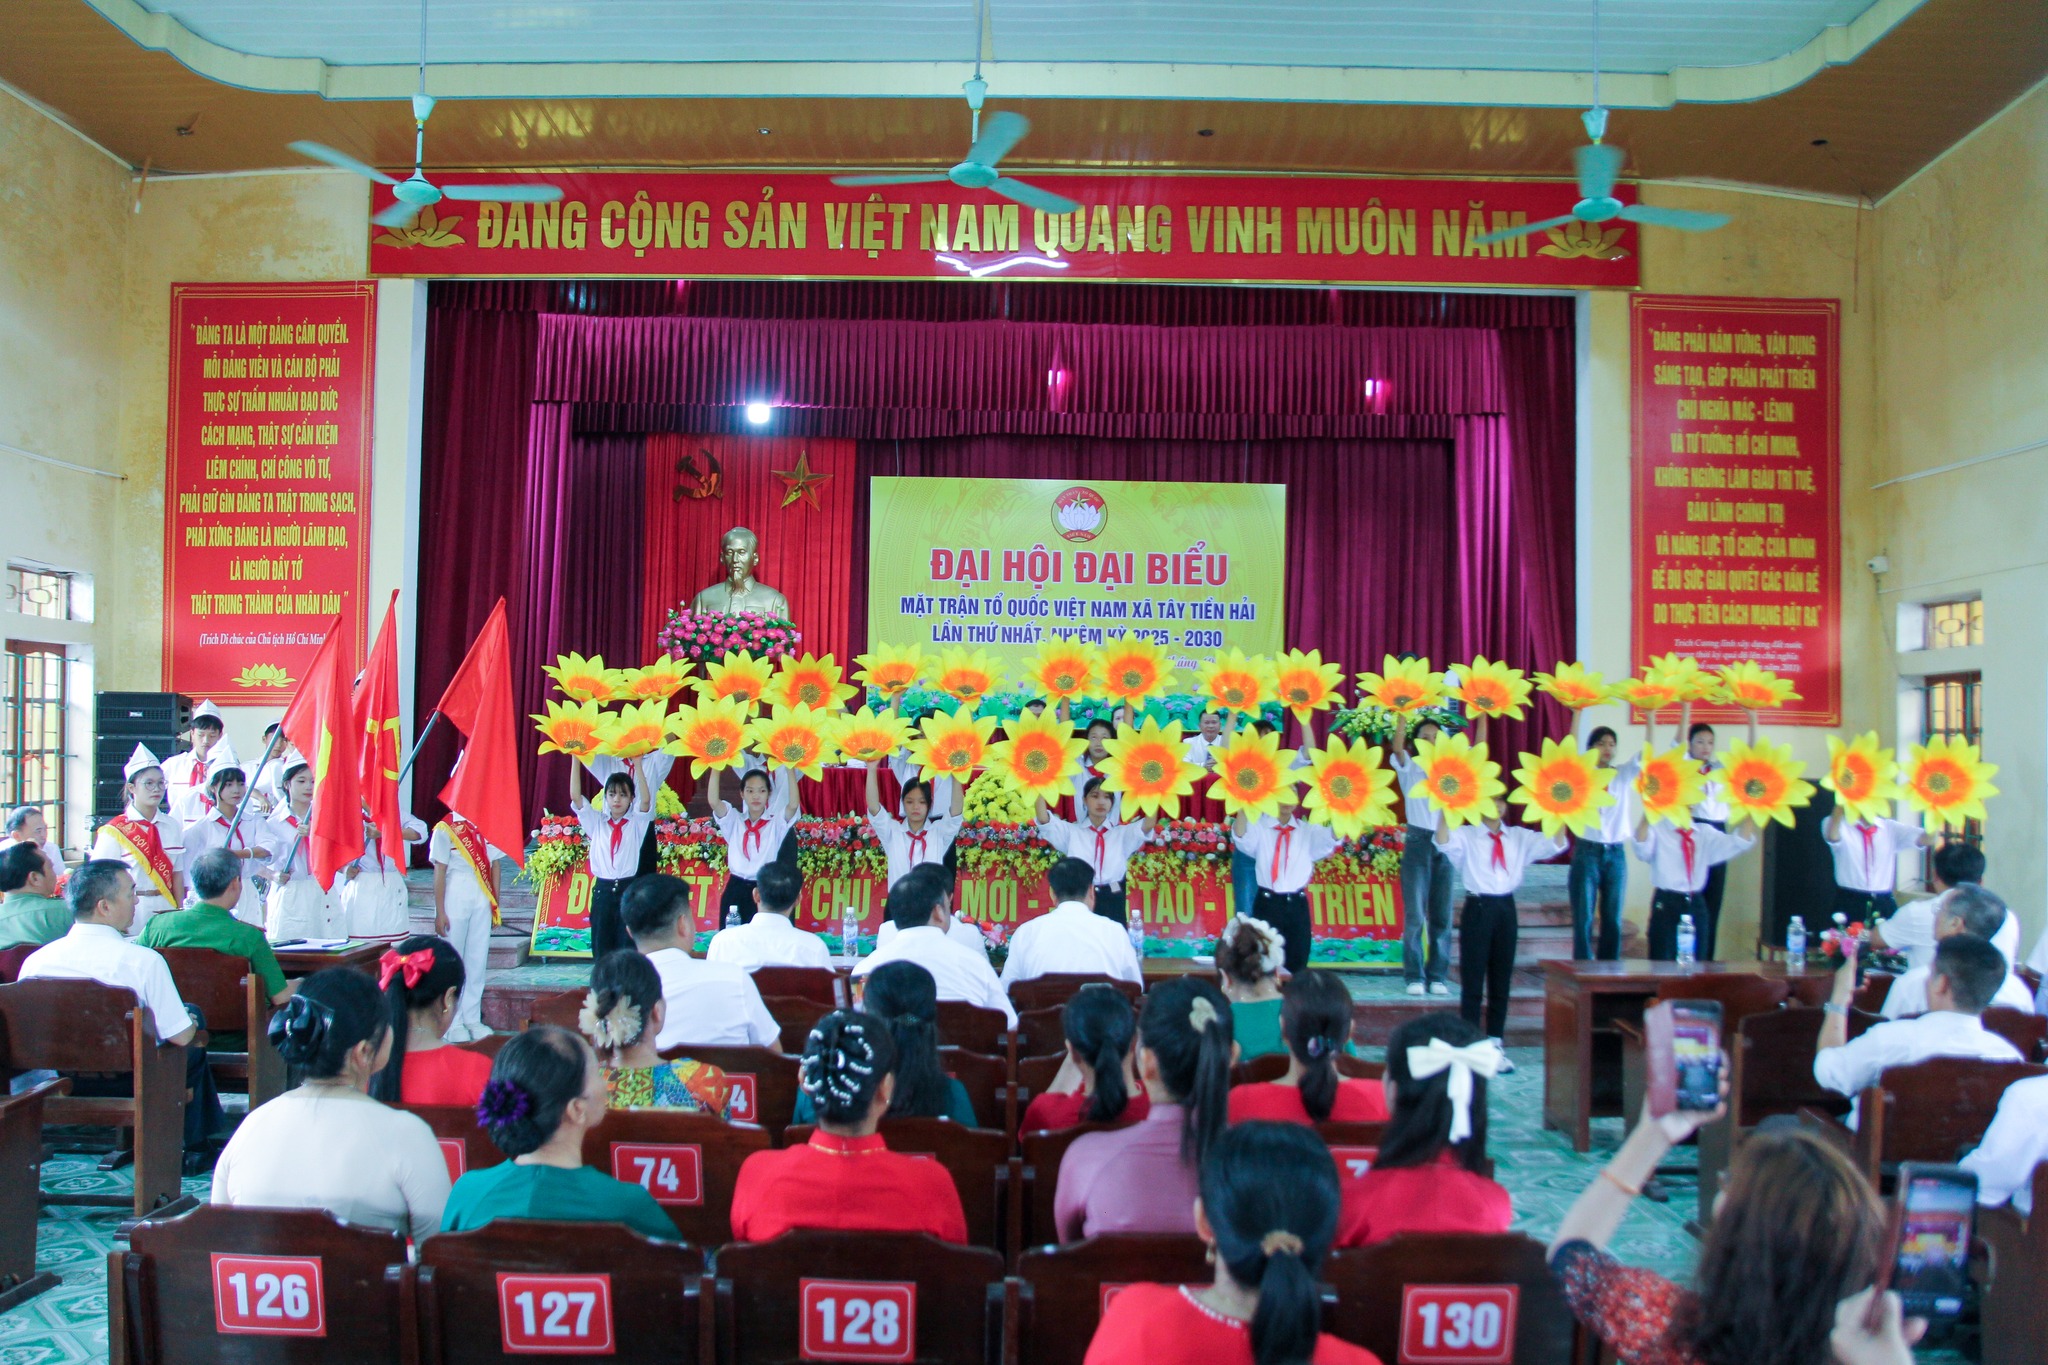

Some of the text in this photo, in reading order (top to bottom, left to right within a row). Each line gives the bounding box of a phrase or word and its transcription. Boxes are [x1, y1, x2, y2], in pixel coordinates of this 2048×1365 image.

[600, 190, 710, 258] CỘNG
[723, 185, 807, 249] SẢN
[824, 192, 910, 259] VIỆT
[920, 203, 1019, 252] NAM
[1033, 204, 1172, 257] QUANG
[1187, 205, 1282, 254] VINH
[1297, 197, 1417, 256] MUÔN
[1432, 199, 1528, 258] NĂM
[222, 325, 233, 344] TA
[235, 321, 246, 344] LÀ
[248, 321, 268, 349] MỘT
[269, 316, 294, 343] ĐẢNG
[295, 316, 316, 343] CẦM
[203, 349, 340, 382] MỖI ĐẢNG VIÊN VÀ CÁN BỘ PHẢI
[203, 391, 225, 416] THỰC
[227, 390, 241, 416] SỰ
[300, 391, 318, 415] ĐẠO
[320, 385, 338, 410] ĐỨC
[201, 416, 338, 449] CÁCH MẠNG, THẬT SỰ CẦN KIỆM
[206, 455, 227, 479] LIÊM
[229, 455, 259, 481] CHÍNH,
[261, 454, 277, 478] CHÍ
[278, 454, 302, 478] CÔNG
[304, 454, 316, 477] VÔ
[179, 485, 356, 516] PHẢI GIỮ GÌN ĐẢNG TA THẬT TRONG SẠCH,
[185, 519, 348, 550] PHẢI XỨNG ĐÁNG LÀ NGƯỜI LÃNH ĐẠO,
[230, 556, 241, 580] LÀ
[243, 554, 270, 580] NGƯỜI
[291, 553, 304, 579] TỚ
[930, 540, 1229, 591] ĐẠI HỘI ĐẠI BIỂU
[191, 590, 213, 619] THẬT
[214, 594, 243, 614] TRUNG
[245, 590, 274, 614] THÀNH
[275, 585, 293, 613] CỦA
[295, 589, 321, 613] NHÂN
[901, 592, 1255, 620] MẶT TRẬN TỔ QUỐC VIỆT NAM XÃ TÂY TIỀN HẢI
[221, 633, 228, 644] Di
[286, 632, 296, 644] Hồ
[297, 633, 309, 644] Chí
[932, 619, 962, 642] LẦN
[967, 621, 999, 643] THỨ
[1184, 630, 1223, 647] 2030
[811, 863, 871, 921] CHỦ
[1139, 881, 1194, 934] TẠO
[633, 1157, 679, 1192] 74
[228, 1271, 310, 1319] 126
[514, 1290, 596, 1338] 127
[816, 1297, 900, 1347] 128
[1419, 1301, 1500, 1349] 130
